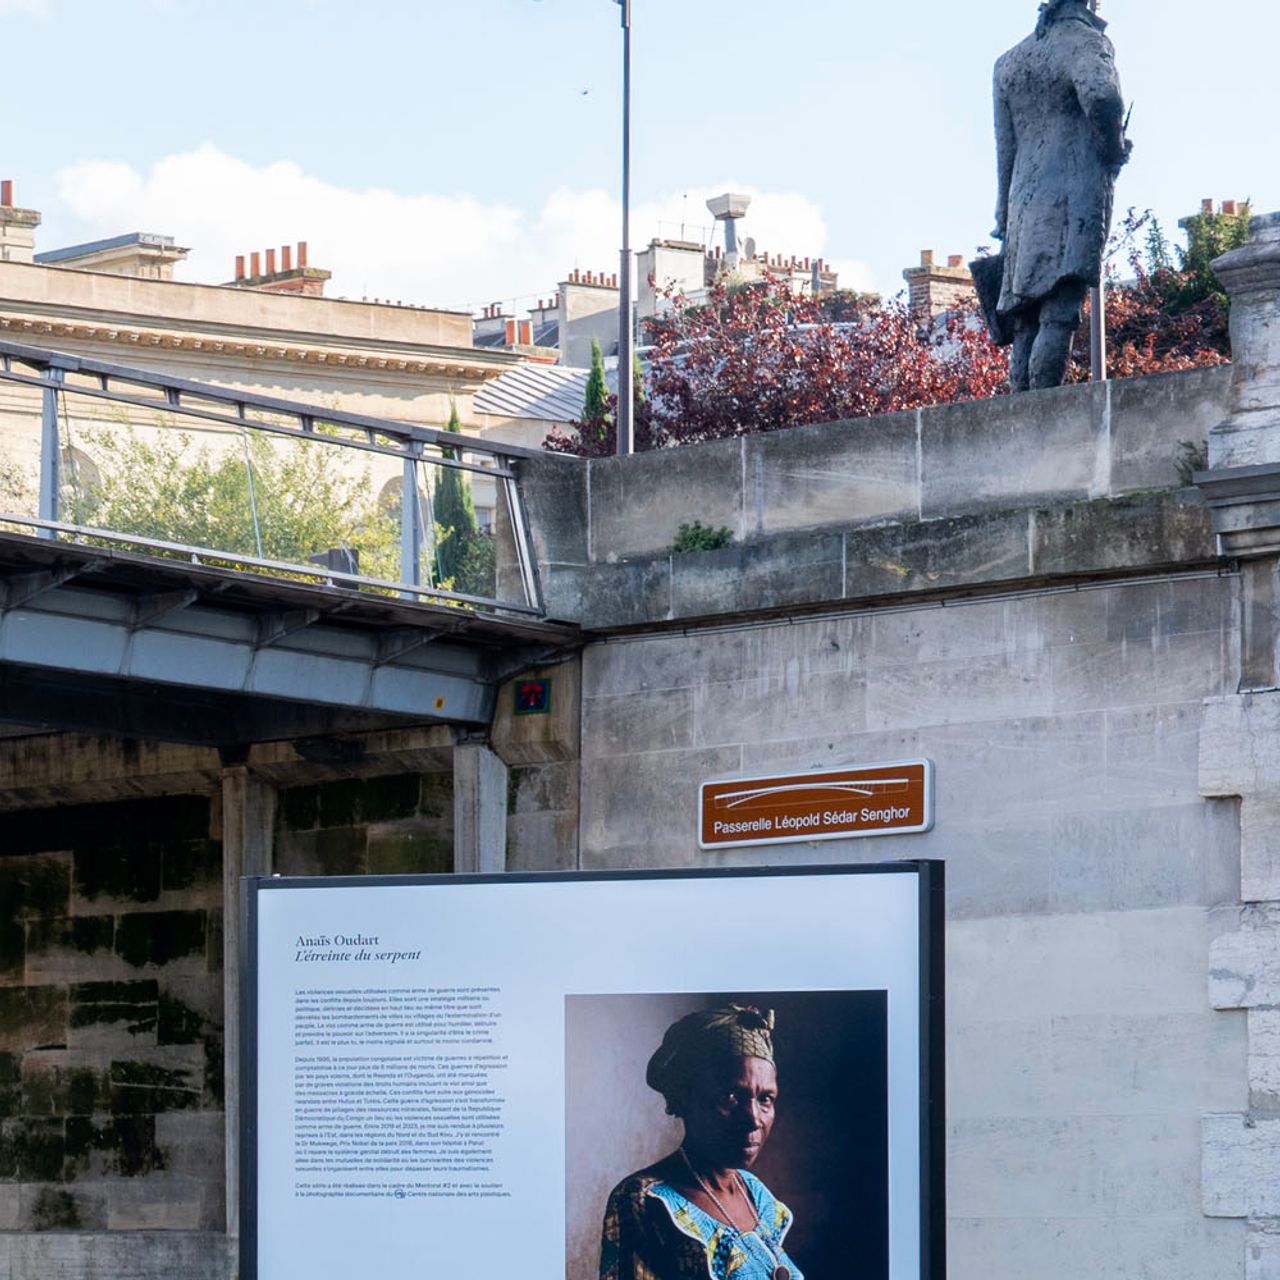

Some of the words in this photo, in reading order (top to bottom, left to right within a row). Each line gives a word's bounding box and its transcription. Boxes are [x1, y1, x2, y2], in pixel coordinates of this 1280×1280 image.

[714, 817, 771, 834] Passerelle
[775, 815, 819, 831] Léopold
[823, 811, 856, 824] Sédar
[861, 807, 910, 822] Senghor
[296, 935, 330, 947] Anaïs
[335, 934, 379, 946] Oudart
[355, 950, 371, 961] du
[374, 950, 421, 963] serpent
